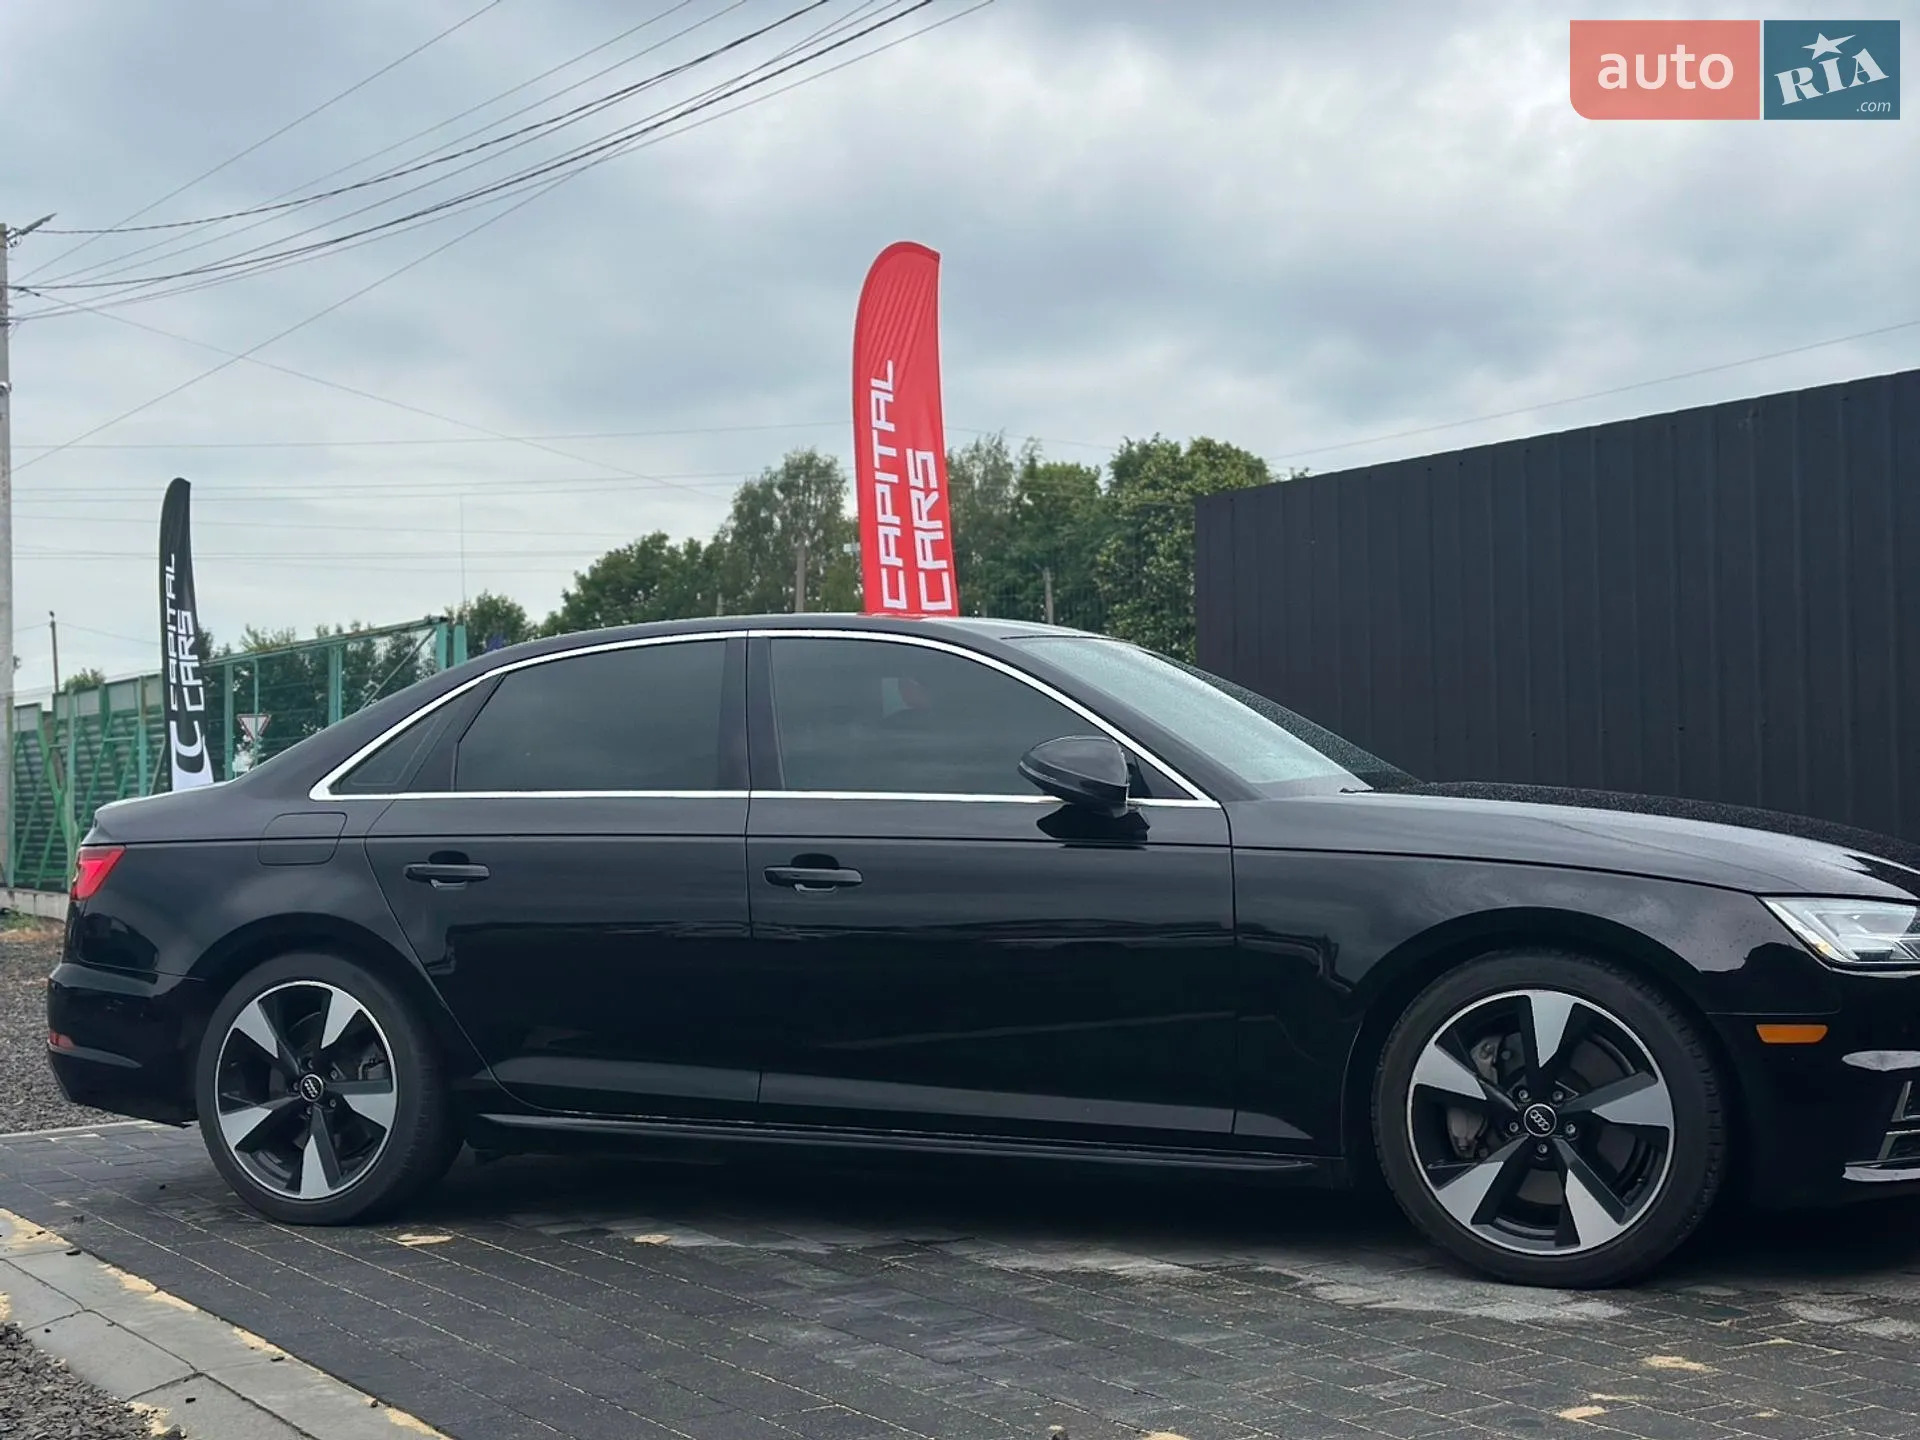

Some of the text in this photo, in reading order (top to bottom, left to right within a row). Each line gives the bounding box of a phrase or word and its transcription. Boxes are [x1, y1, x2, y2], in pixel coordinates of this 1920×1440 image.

[870, 360, 908, 610] CAPITAL
[906, 448, 953, 611] CARS
[165, 553, 178, 712] CAPITAL
[177, 609, 205, 712] CARS
